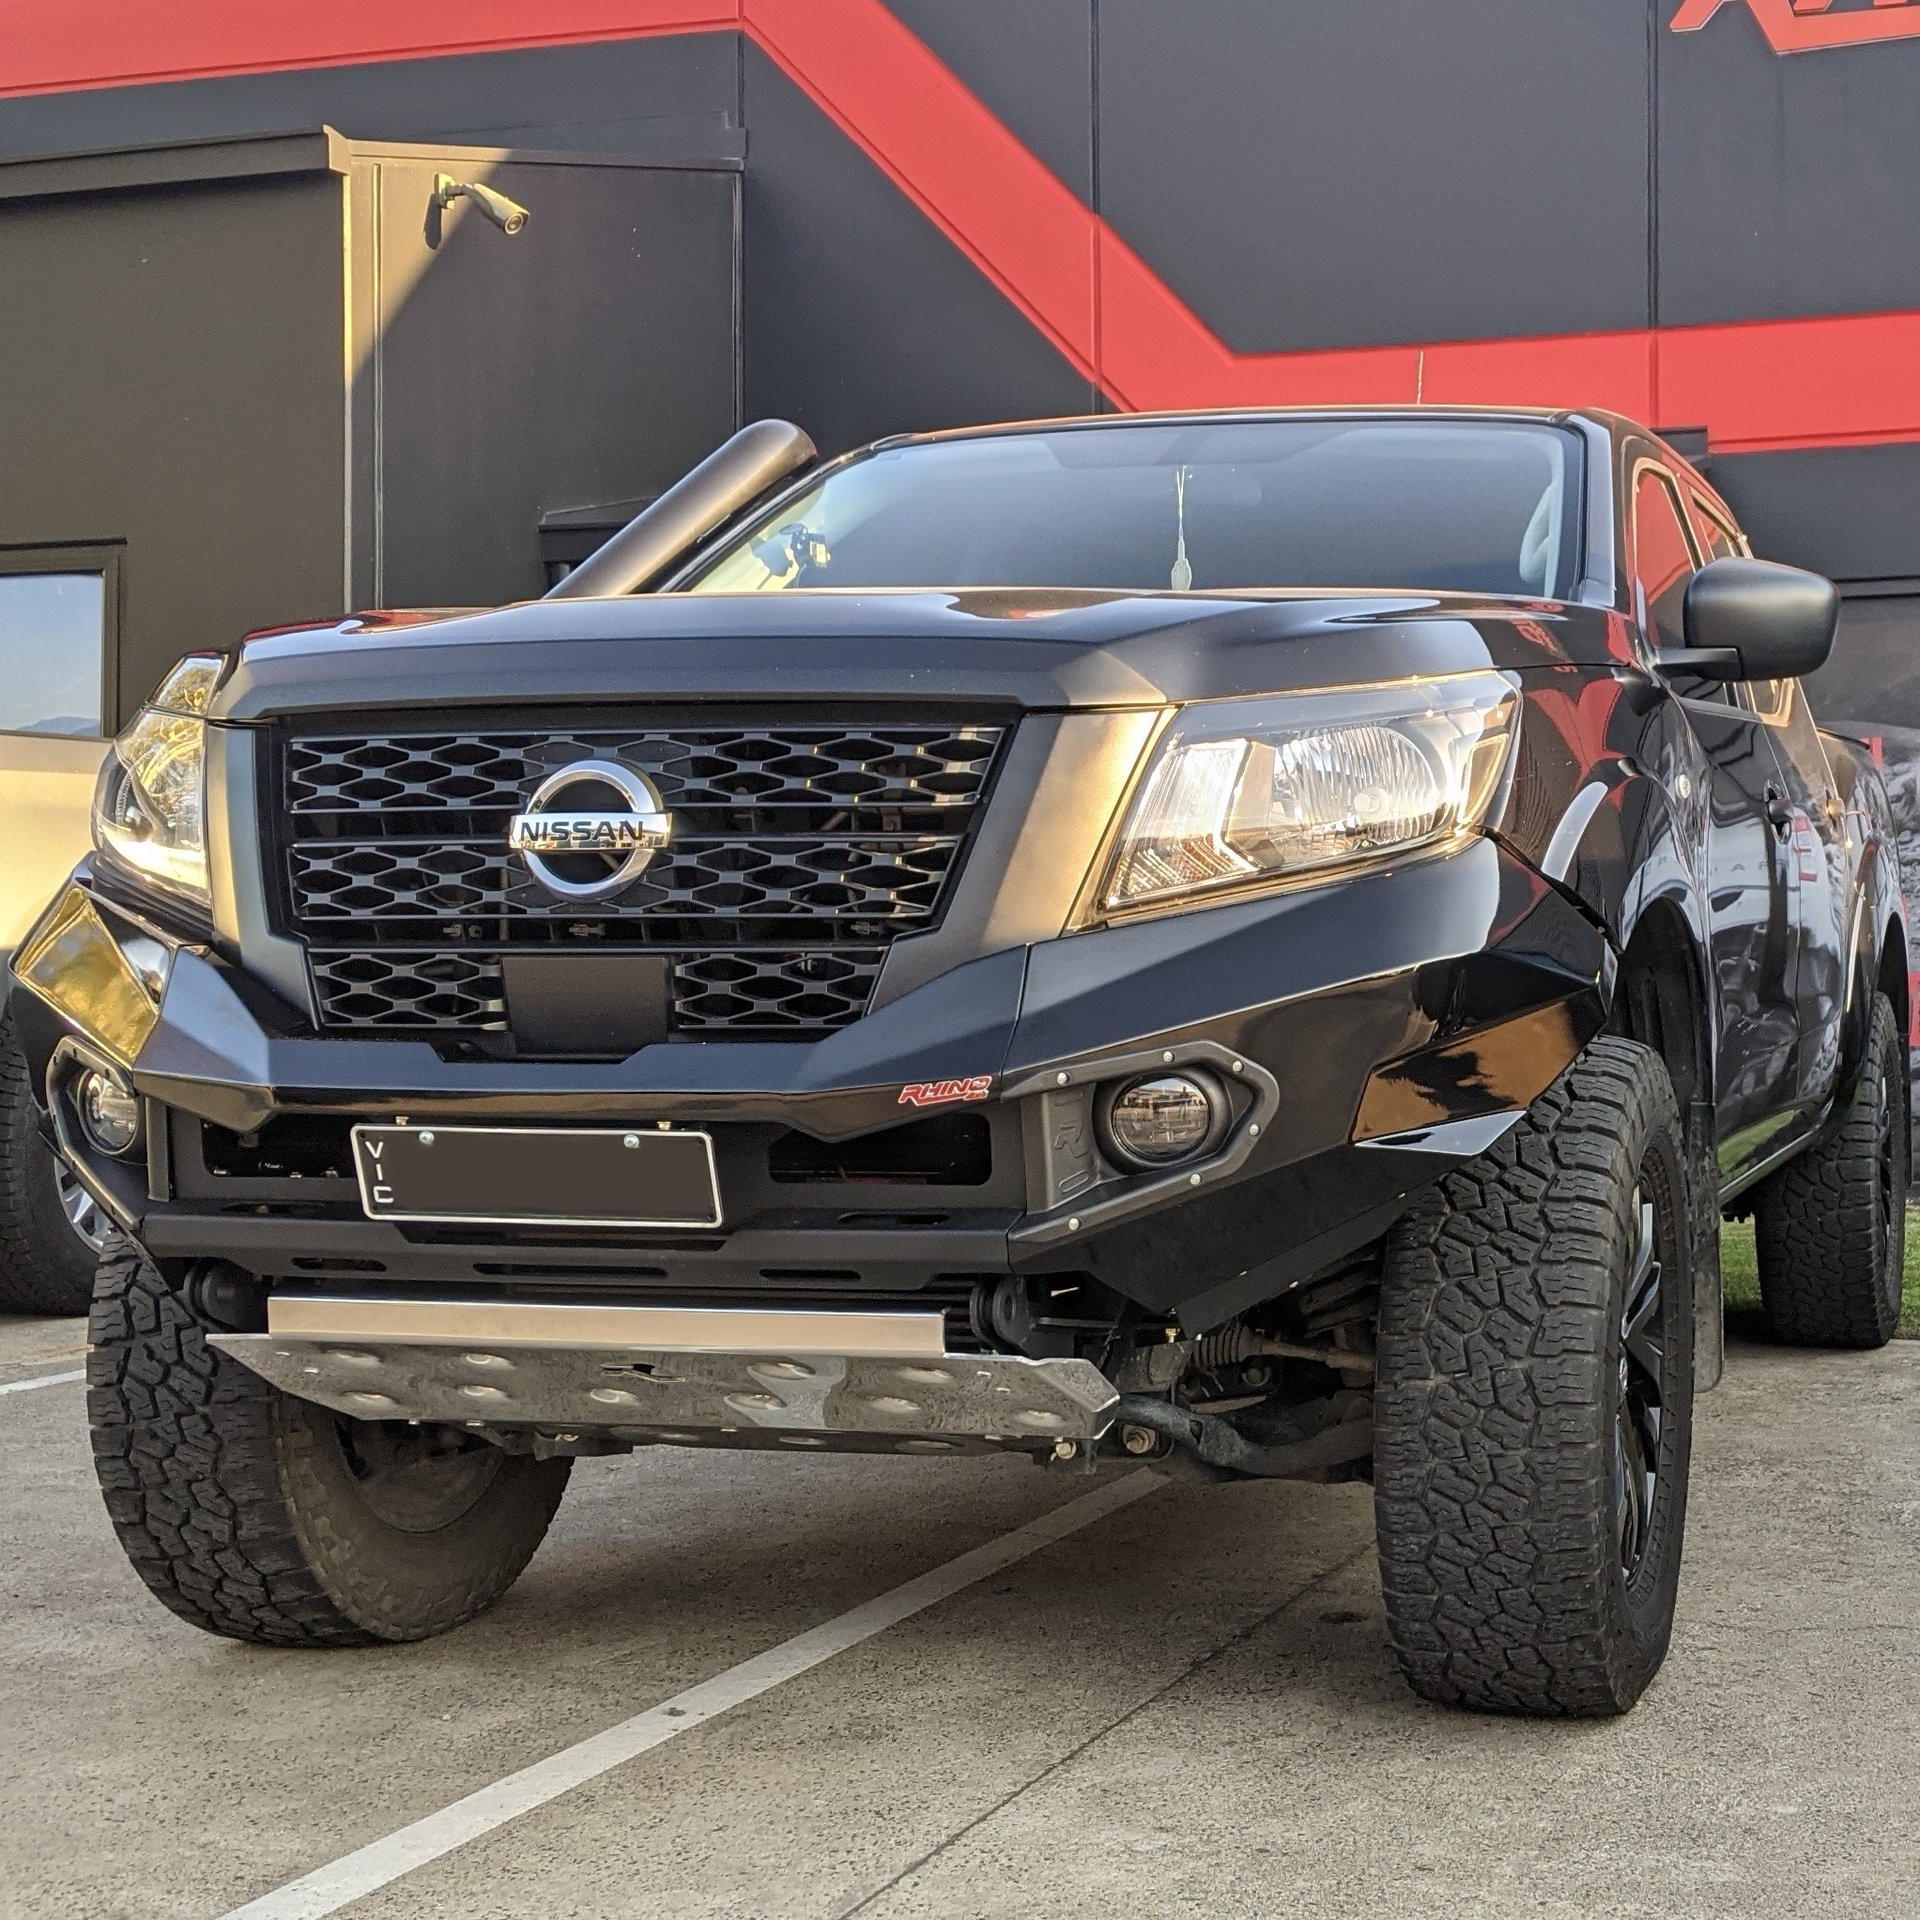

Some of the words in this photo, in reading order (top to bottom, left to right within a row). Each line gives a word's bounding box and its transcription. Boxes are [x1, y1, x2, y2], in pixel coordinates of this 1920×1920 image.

[520, 820, 643, 842] NISSAN
[898, 1076, 992, 1106] RHINO
[365, 1141, 394, 1204] VIC
